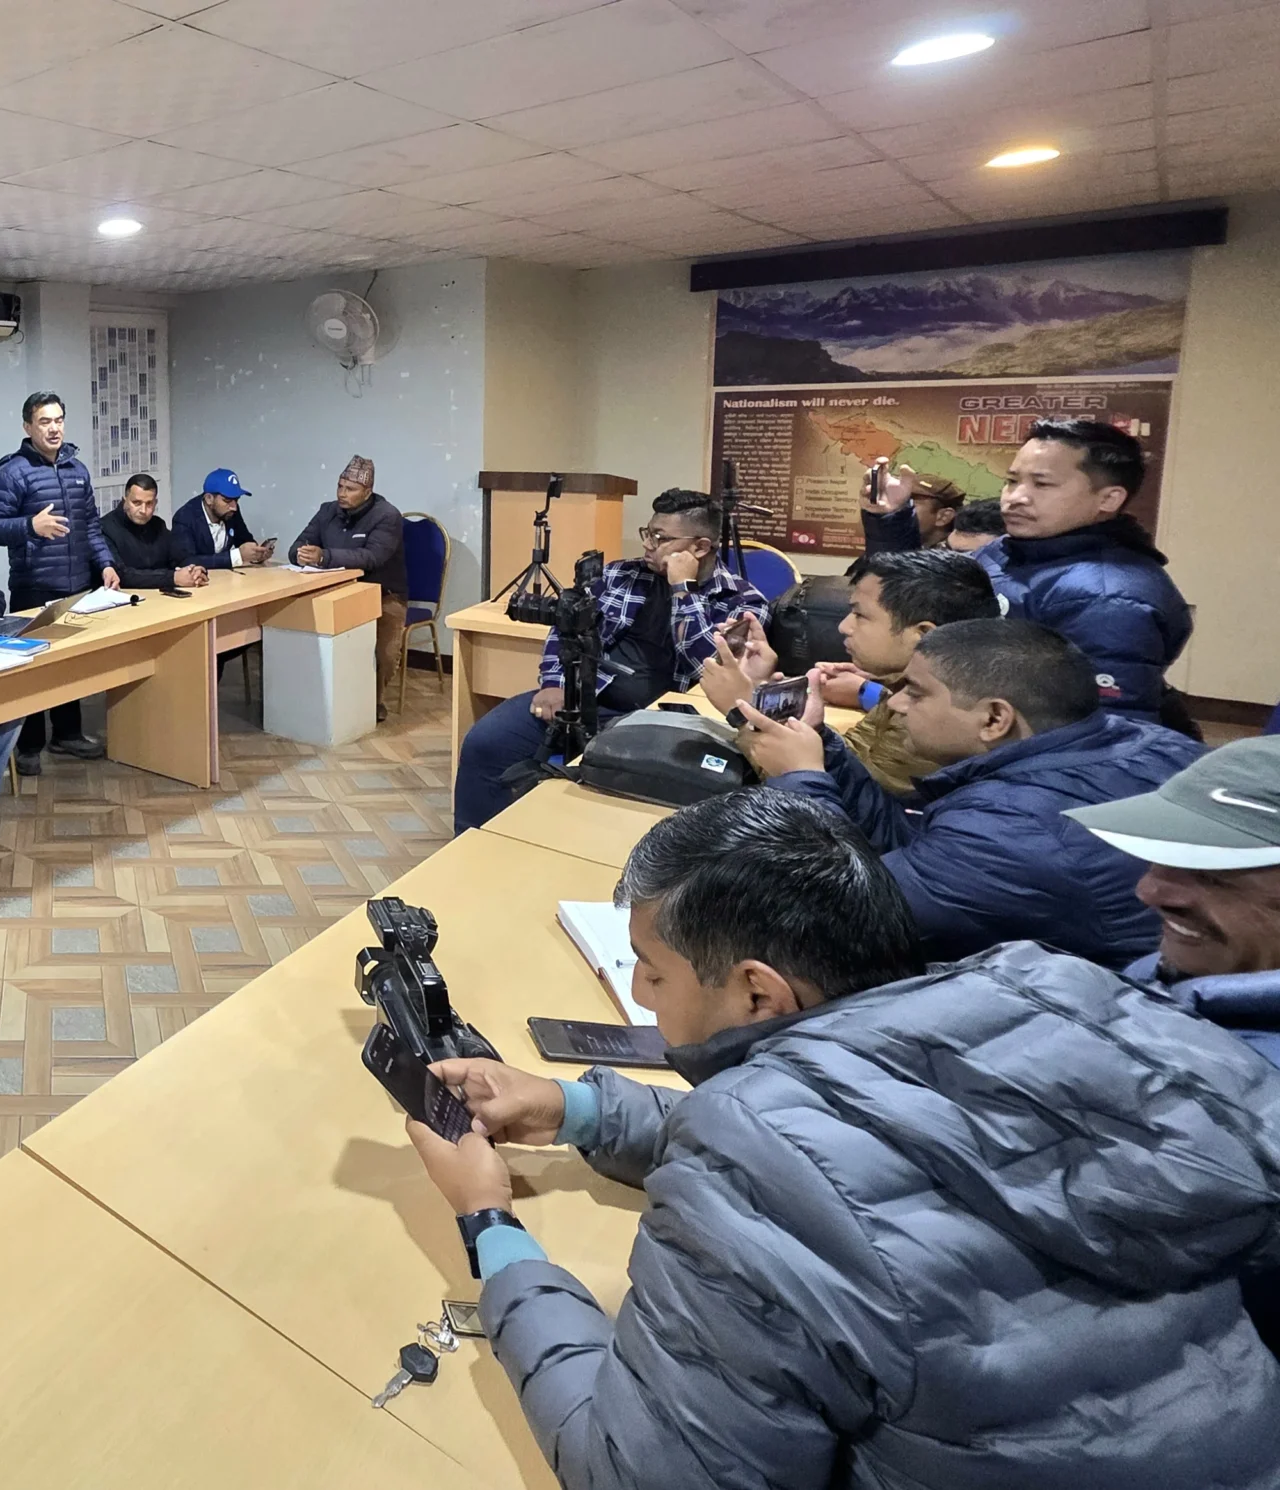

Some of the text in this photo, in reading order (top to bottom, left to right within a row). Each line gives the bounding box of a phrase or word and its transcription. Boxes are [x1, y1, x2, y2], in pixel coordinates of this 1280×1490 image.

[723, 398, 798, 408] Nationalism
[801, 397, 825, 407] will
[829, 397, 869, 407] never
[959, 394, 1107, 411] GREATER
